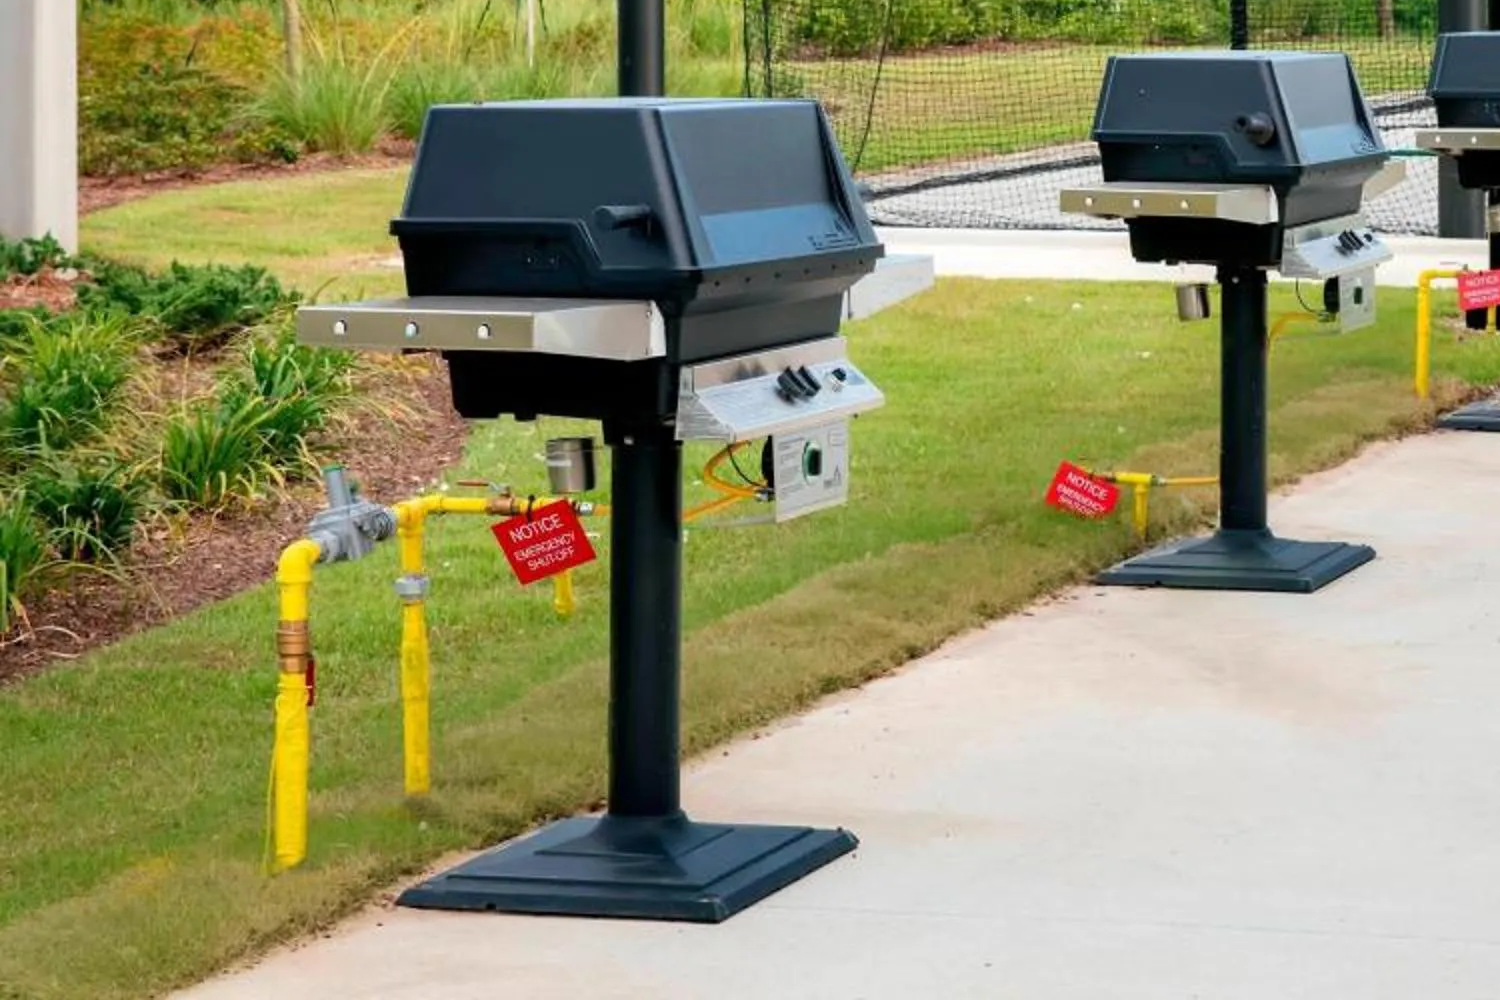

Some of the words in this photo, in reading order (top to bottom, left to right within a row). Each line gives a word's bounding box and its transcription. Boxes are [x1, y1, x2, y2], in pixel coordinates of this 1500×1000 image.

[1066, 471, 1109, 501] NOTICE
[508, 513, 566, 543] NOTICE
[513, 531, 576, 561] EMERGENCY
